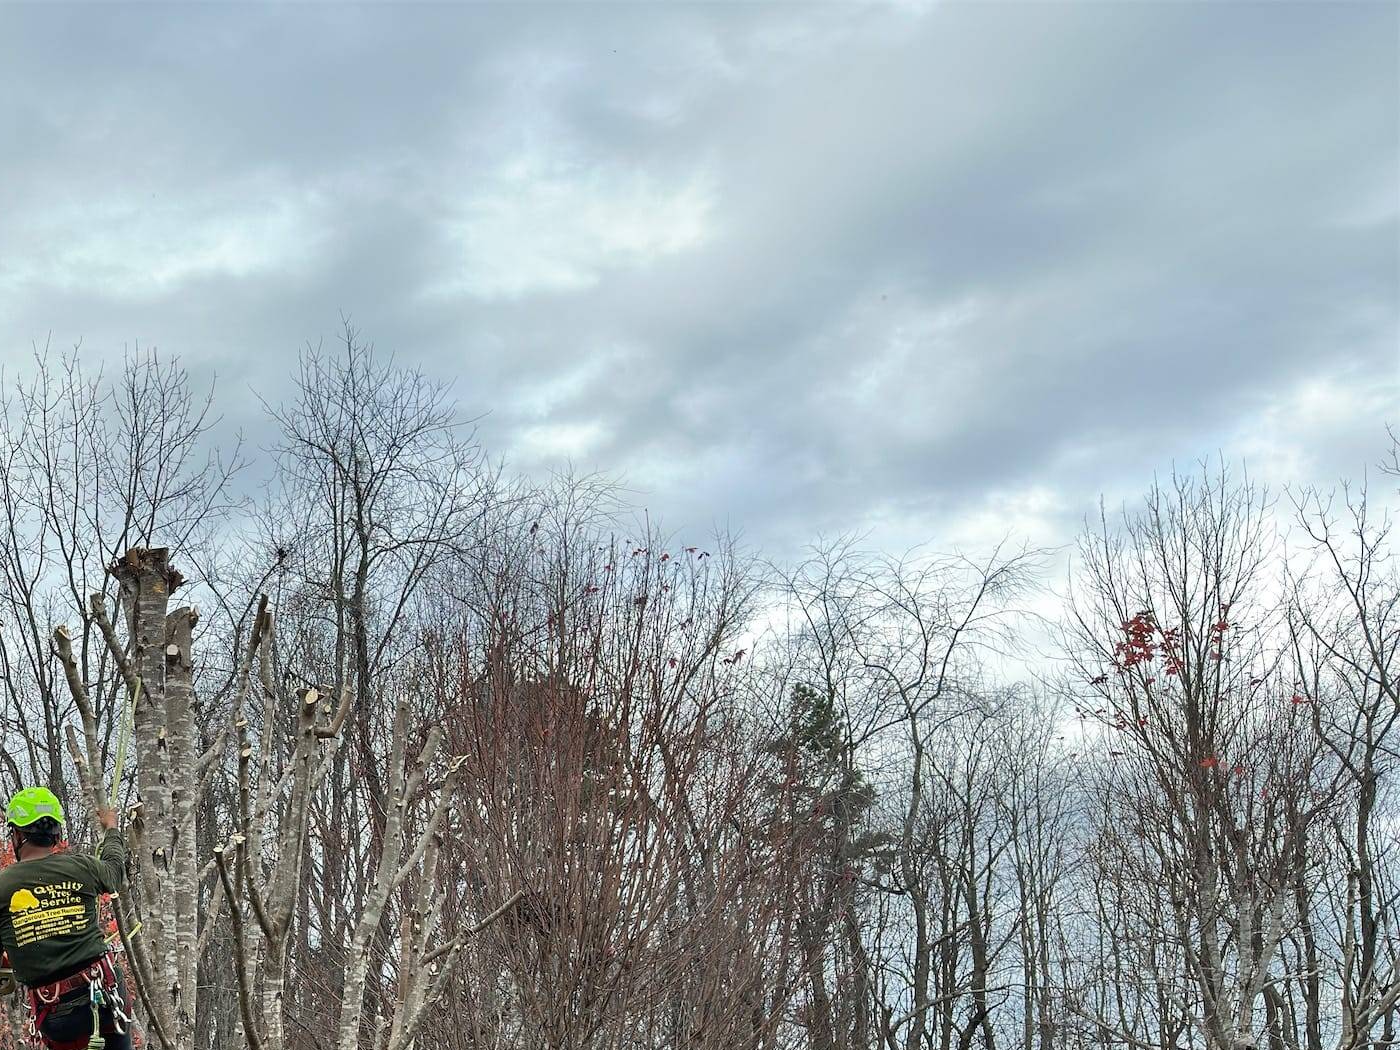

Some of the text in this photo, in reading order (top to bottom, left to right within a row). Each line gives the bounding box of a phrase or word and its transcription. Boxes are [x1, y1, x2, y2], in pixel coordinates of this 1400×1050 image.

[34, 881, 83, 894] Quality
[49, 890, 72, 899] Tree
[41, 896, 81, 908] Service
